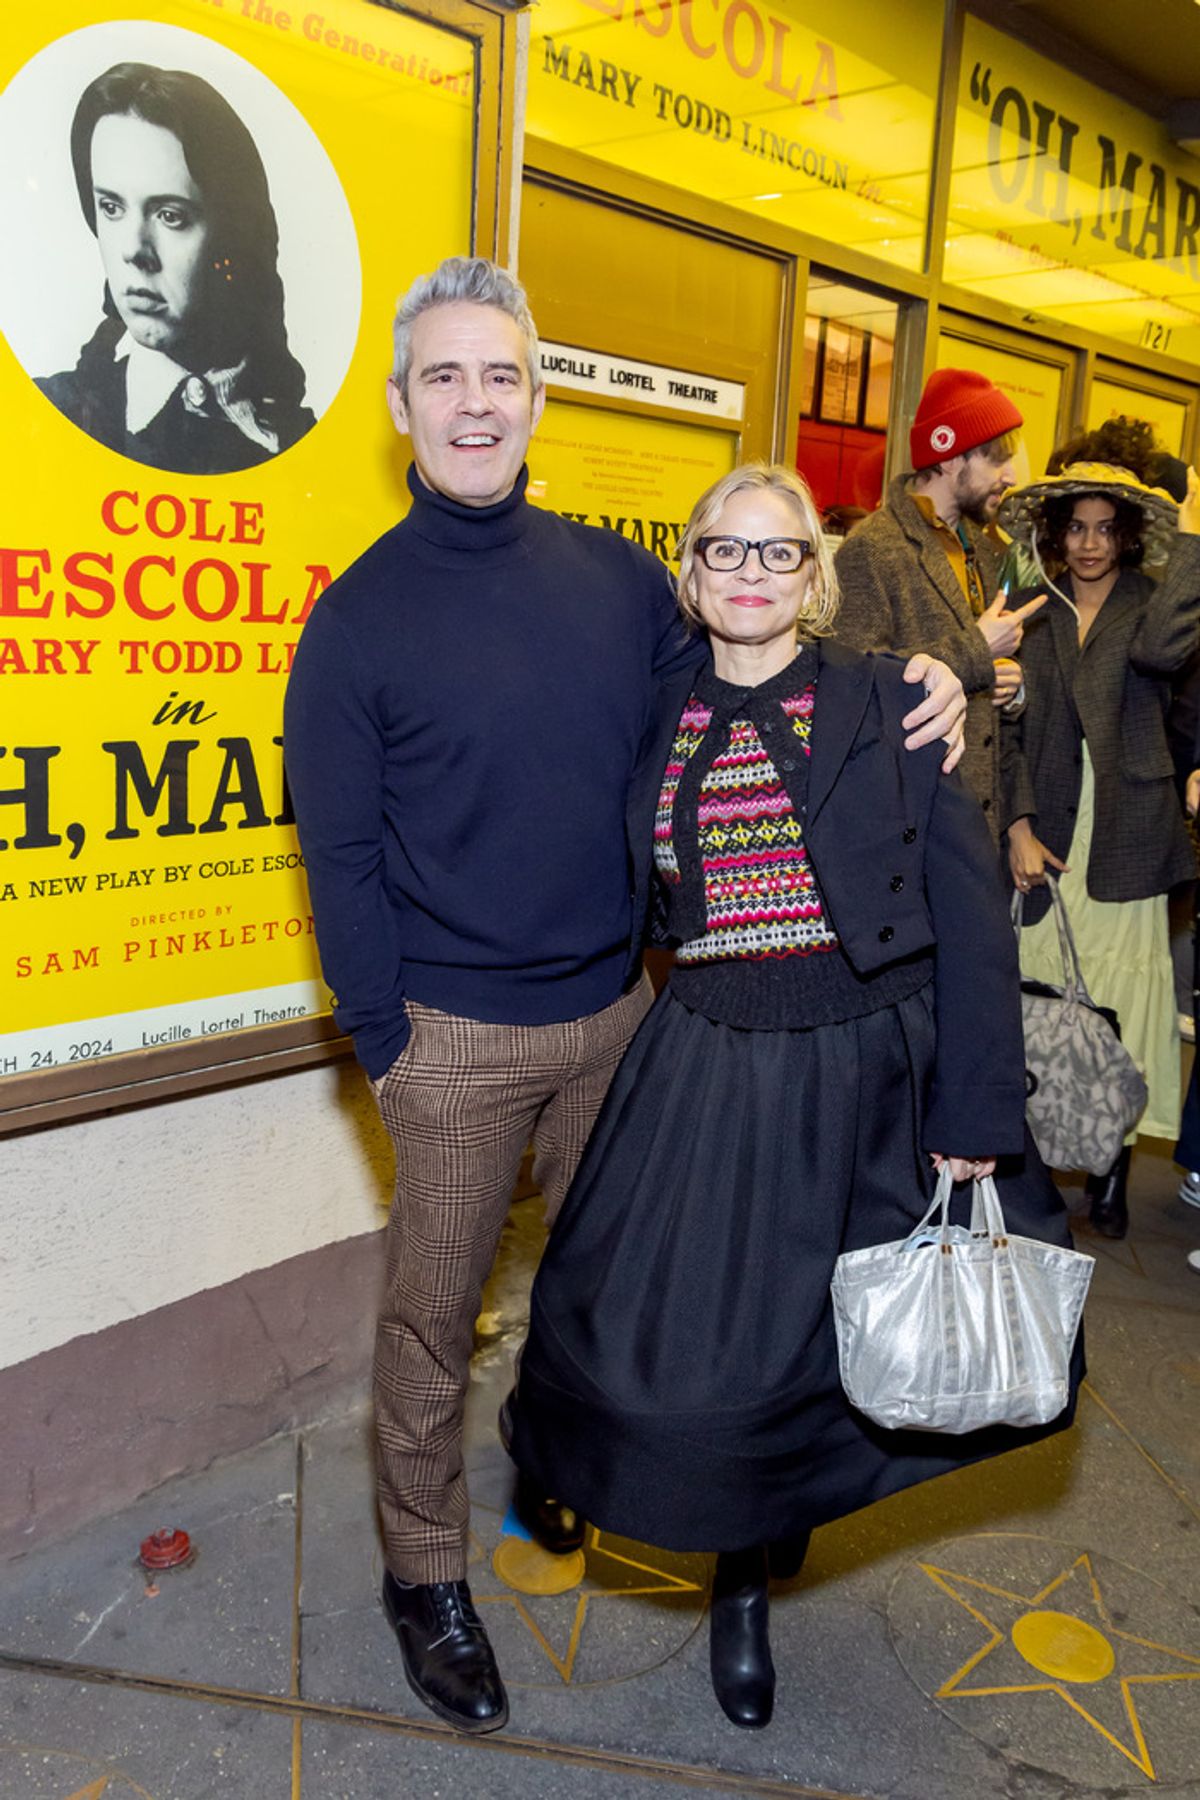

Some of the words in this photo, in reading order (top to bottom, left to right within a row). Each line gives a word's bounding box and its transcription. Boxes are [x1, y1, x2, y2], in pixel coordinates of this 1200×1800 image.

[303, 14, 471, 97] Generation!
[577, 0, 844, 122] COLA
[542, 35, 642, 109] MARY
[653, 84, 732, 143] TODD
[741, 122, 849, 191] LINCOLN
[541, 354, 596, 379] LUCILLE
[609, 368, 656, 392] LORTEL
[668, 381, 719, 404] THEATRE
[101, 490, 265, 545] COLE
[119, 640, 243, 674] TODD
[152, 692, 218, 726] in
[1, 884, 18, 901] A
[29, 877, 87, 898] NEW
[96, 869, 156, 891] PLAY
[164, 863, 191, 883] BY
[199, 858, 255, 879] COLE
[131, 908, 206, 927] DIRECTED
[215, 904, 233, 916] BY
[16, 946, 100, 978] SAM
[30, 1050, 58, 1068] 24,
[69, 1039, 113, 1060] 2024
[142, 1025, 192, 1046] Lucille
[201, 1013, 244, 1035] Lortel
[254, 1004, 306, 1026] Theatre
